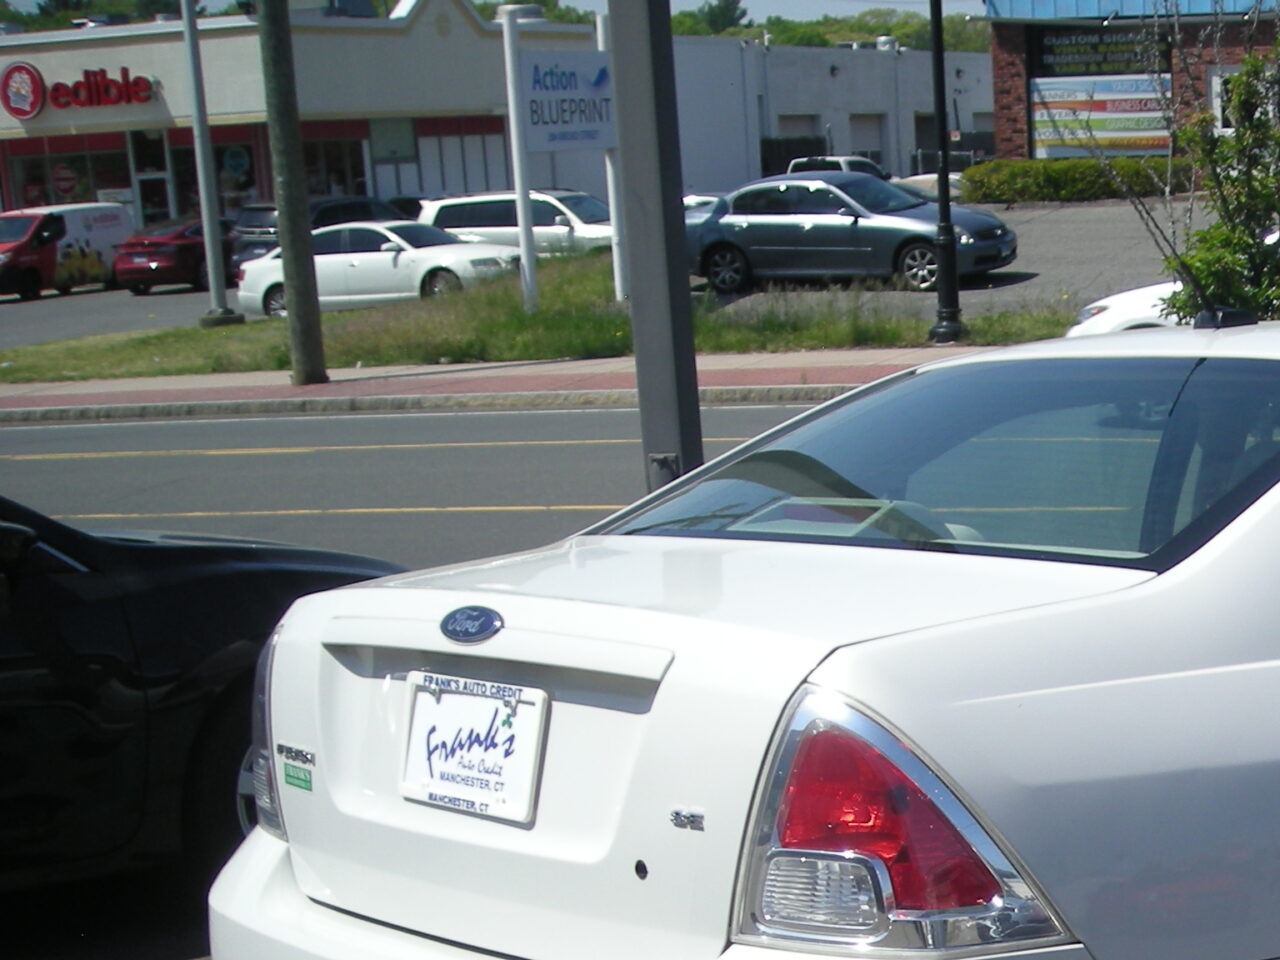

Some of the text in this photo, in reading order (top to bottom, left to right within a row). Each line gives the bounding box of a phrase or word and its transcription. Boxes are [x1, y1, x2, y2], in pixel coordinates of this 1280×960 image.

[1044, 34, 1099, 46] CUSTOM
[51, 67, 152, 109] edible
[532, 64, 578, 91] Action
[529, 98, 611, 125] BLUEPRINT
[447, 609, 485, 633] Ford
[424, 675, 524, 699] FRANK'S AUTO CREDIT
[427, 707, 515, 779] Frank's
[439, 770, 505, 792] MANCHESTER, CT
[428, 791, 489, 813] MANCHESTER, CT
